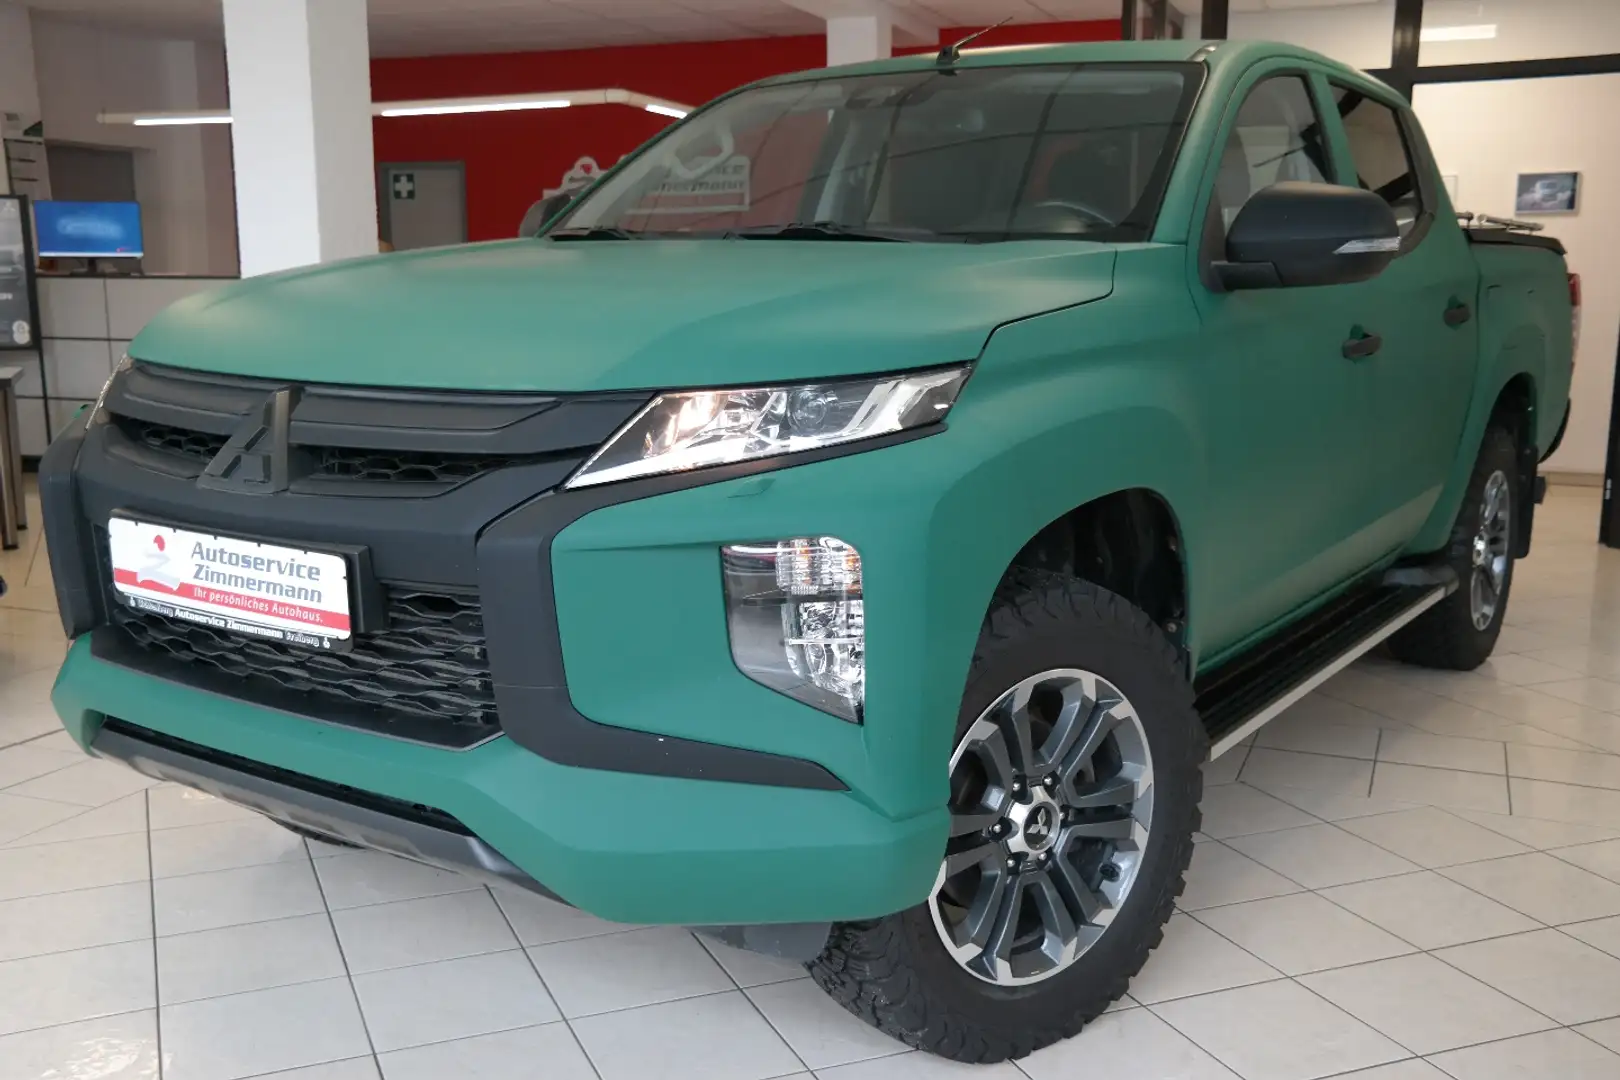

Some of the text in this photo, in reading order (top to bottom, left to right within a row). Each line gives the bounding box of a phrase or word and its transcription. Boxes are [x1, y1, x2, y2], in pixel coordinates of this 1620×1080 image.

[191, 541, 321, 582] Autoservice
[193, 564, 322, 604] Zimmermann
[174, 609, 225, 628] Autoservice
[226, 618, 284, 639] Zimmermann
[194, 587, 324, 624] Ihr persönliches Autohaus.
